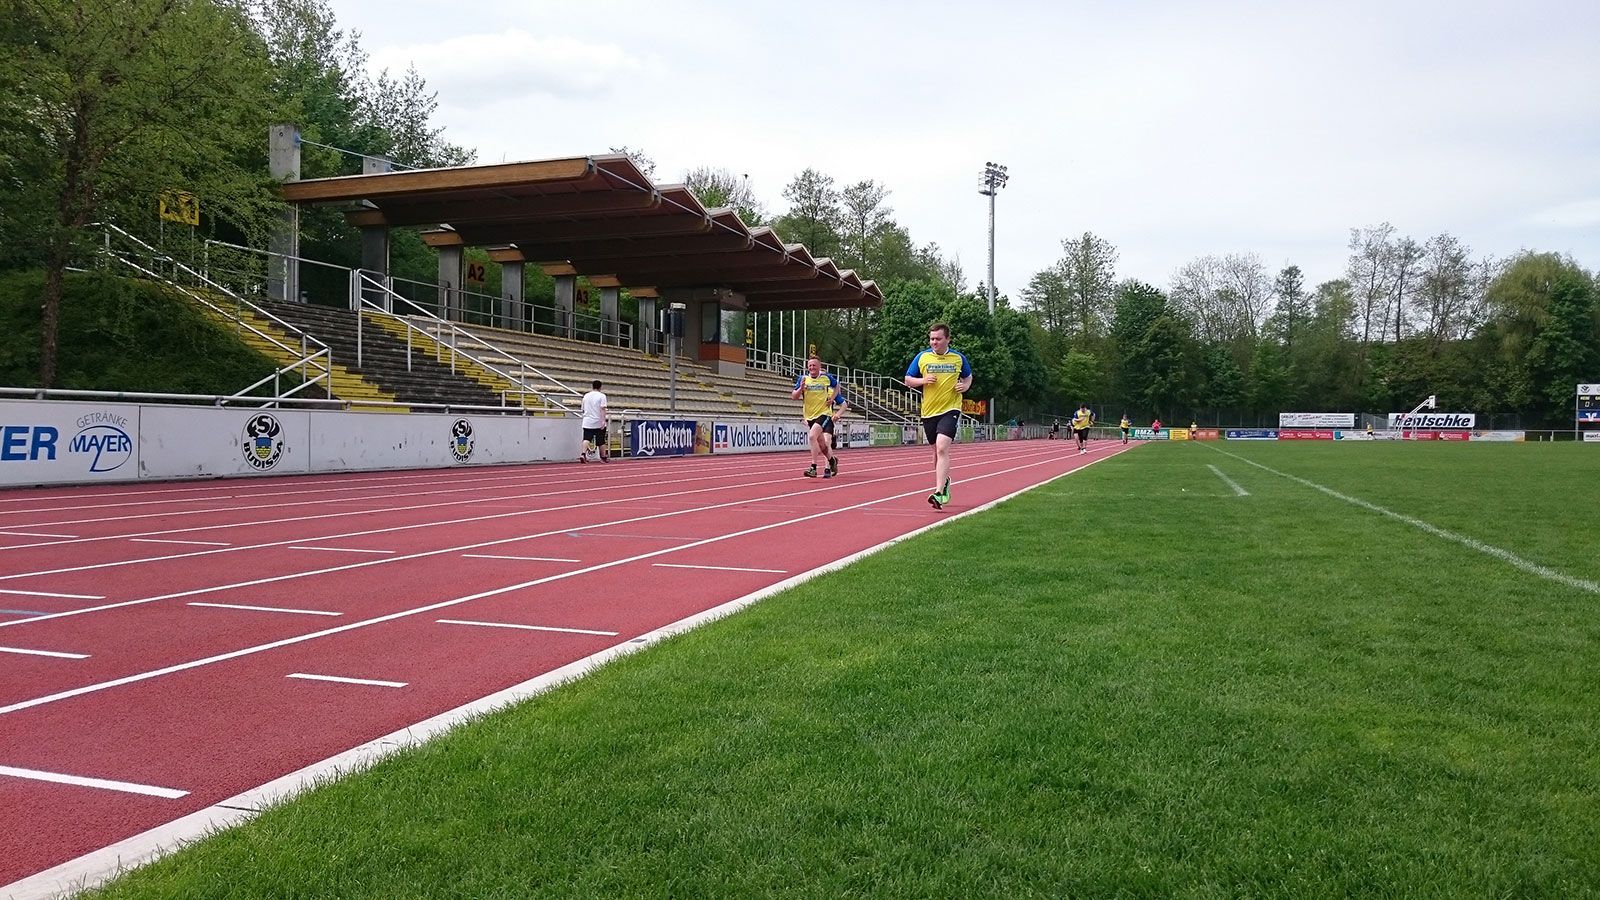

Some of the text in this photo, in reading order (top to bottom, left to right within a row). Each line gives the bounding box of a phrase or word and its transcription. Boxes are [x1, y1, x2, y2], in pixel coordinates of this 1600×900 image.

[467, 263, 485, 282] A2
[576, 288, 588, 304] A3
[76, 411, 128, 429] GETRÄNKE
[0, 426, 58, 461] ER
[636, 421, 693, 456] Landskron
[730, 425, 808, 447] Volksbank Bautzen
[70, 434, 130, 470] MAYER
[243, 441, 283, 468] BUDISSA
